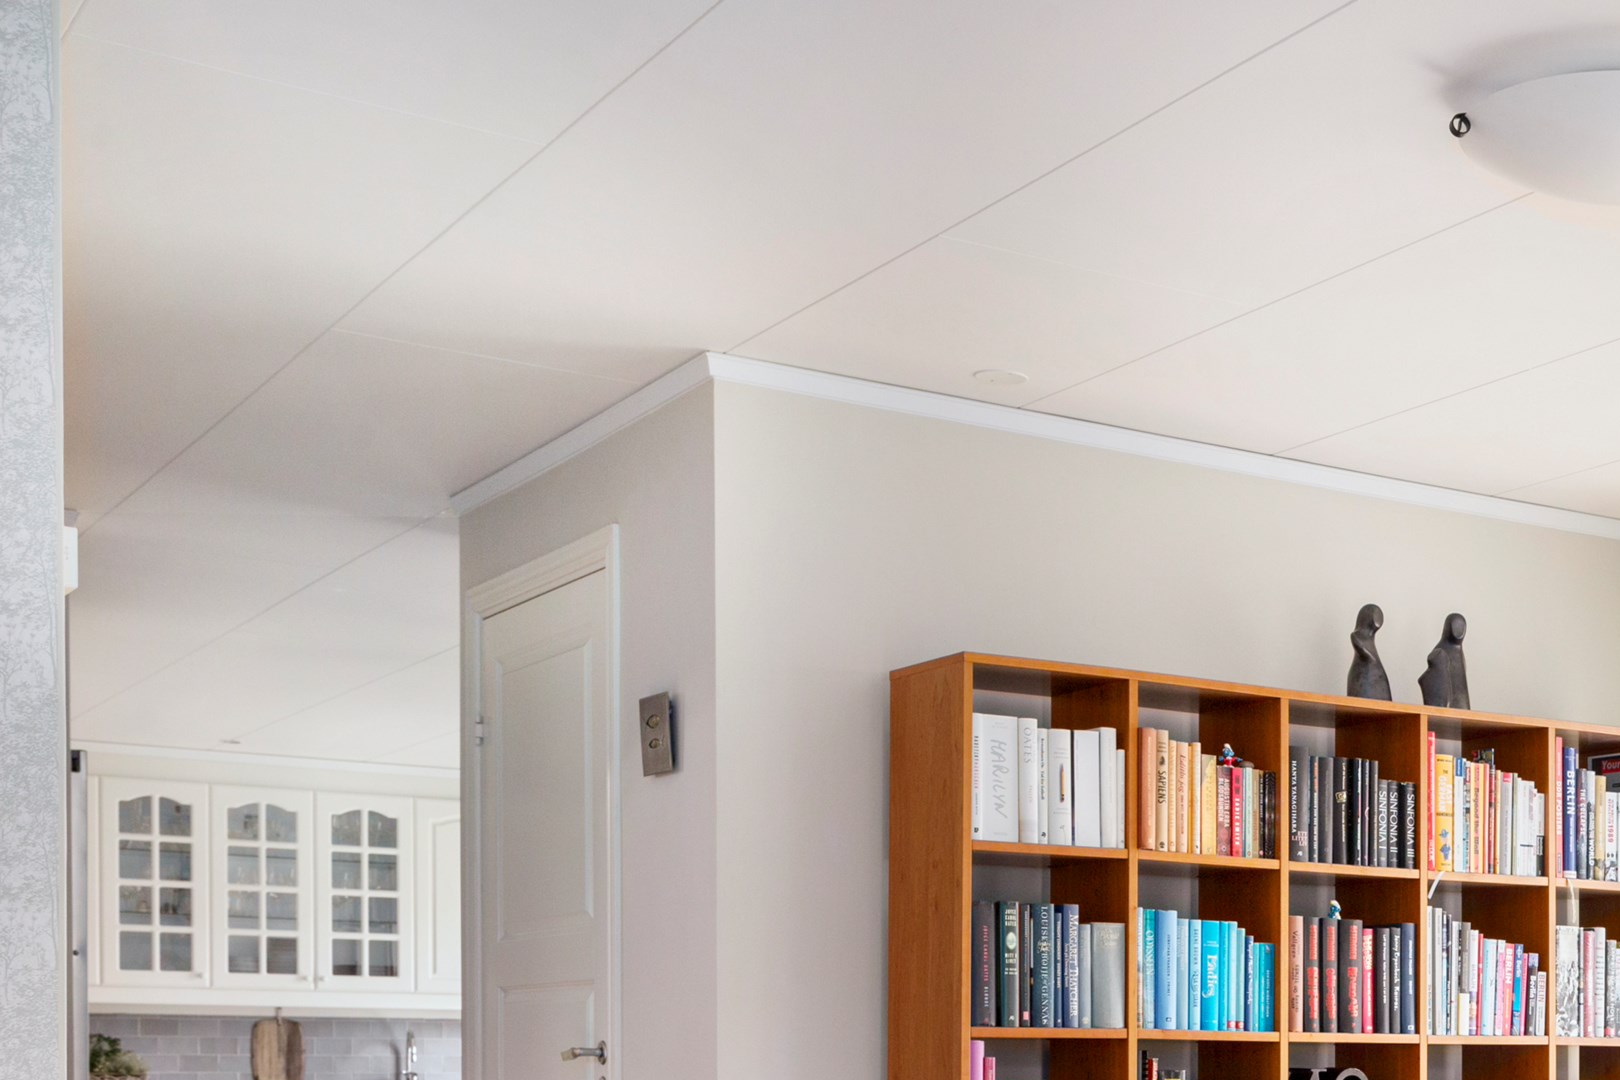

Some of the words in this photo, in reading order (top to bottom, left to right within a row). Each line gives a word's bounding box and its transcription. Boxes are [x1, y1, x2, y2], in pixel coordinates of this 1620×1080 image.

[1023, 727, 1033, 764] OATES
[990, 738, 1010, 819] MARILYN
[1158, 770, 1168, 805] SAPIENS
[1566, 770, 1576, 815] BERLIN
[1379, 790, 1387, 842] SINFONIA
[1390, 791, 1398, 842] SINFONIA
[1406, 793, 1415, 845] SINFONIA
[1406, 848, 1415, 858] III
[1040, 906, 1049, 942] LOUISE
[1069, 914, 1079, 966] MARGARET
[1291, 930, 1299, 959] Vallgren
[1392, 934, 1400, 951] Jenny
[1392, 951, 1400, 984] Erpenbeck
[1505, 948, 1513, 984] BERLIN
[1069, 967, 1079, 1017] THATCHER
[1529, 975, 1537, 998] Berlin
[1537, 974, 1546, 1003] BERLIN
